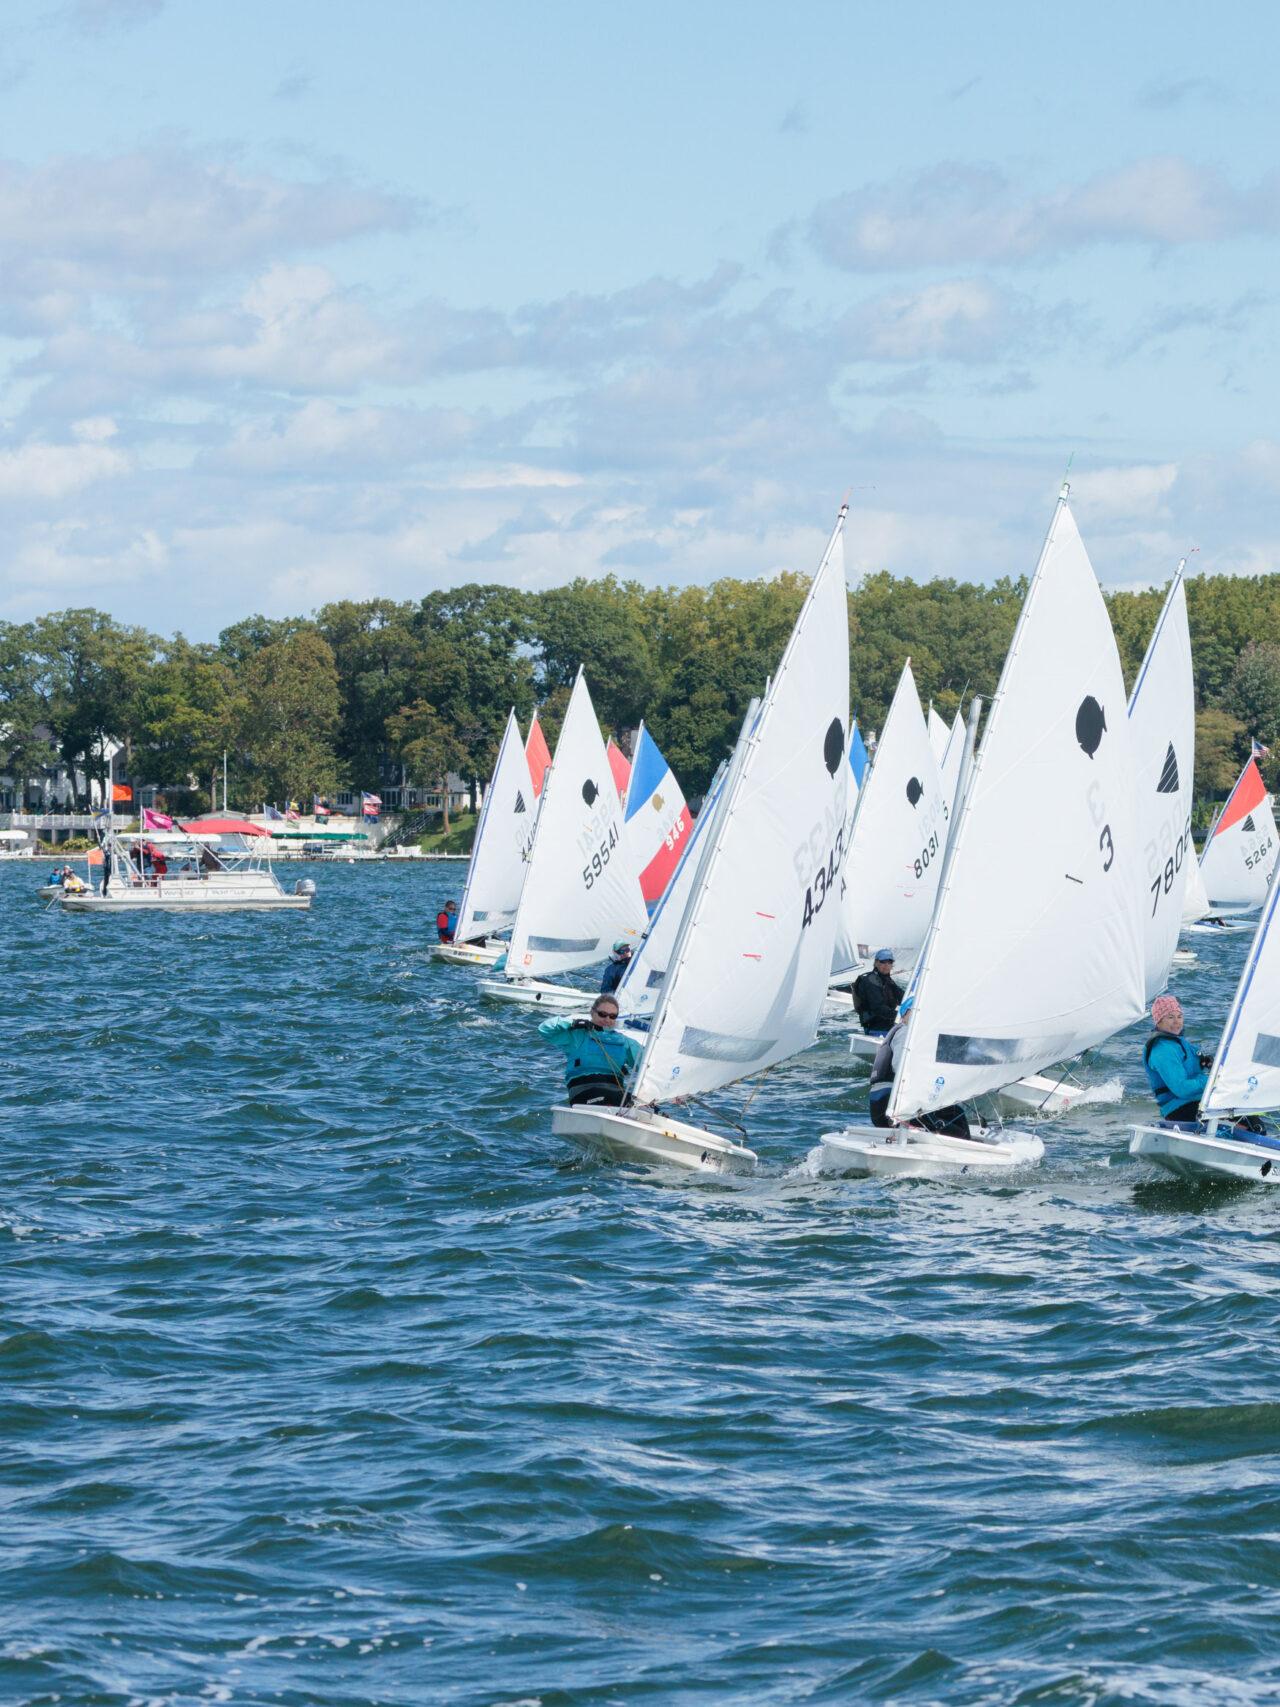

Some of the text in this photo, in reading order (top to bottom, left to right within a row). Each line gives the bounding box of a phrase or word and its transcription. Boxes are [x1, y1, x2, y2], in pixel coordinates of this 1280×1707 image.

[583, 821, 619, 890] 59541
[666, 816, 685, 851] 946
[914, 830, 939, 879] 8031
[1100, 824, 1114, 872] 3
[1245, 836, 1273, 870] 5264
